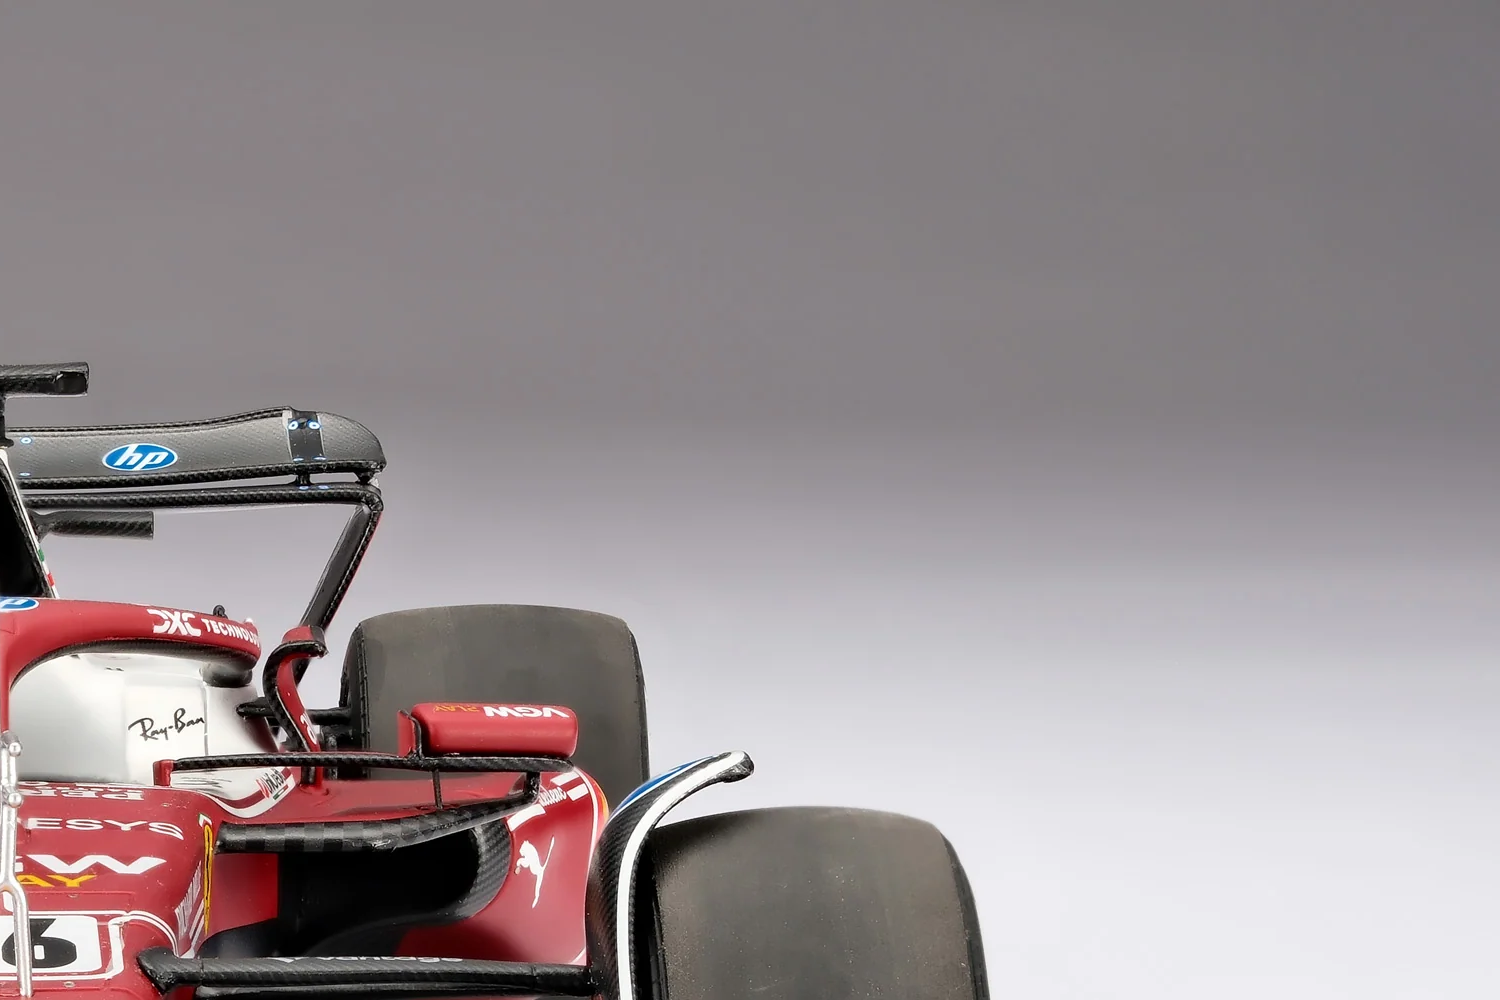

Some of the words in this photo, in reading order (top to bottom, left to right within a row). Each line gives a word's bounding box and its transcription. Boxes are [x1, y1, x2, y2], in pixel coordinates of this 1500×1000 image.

[113, 443, 169, 471] hp
[147, 608, 201, 637] DXC
[128, 707, 205, 741] Ray-Ban
[483, 706, 570, 718] VGW
